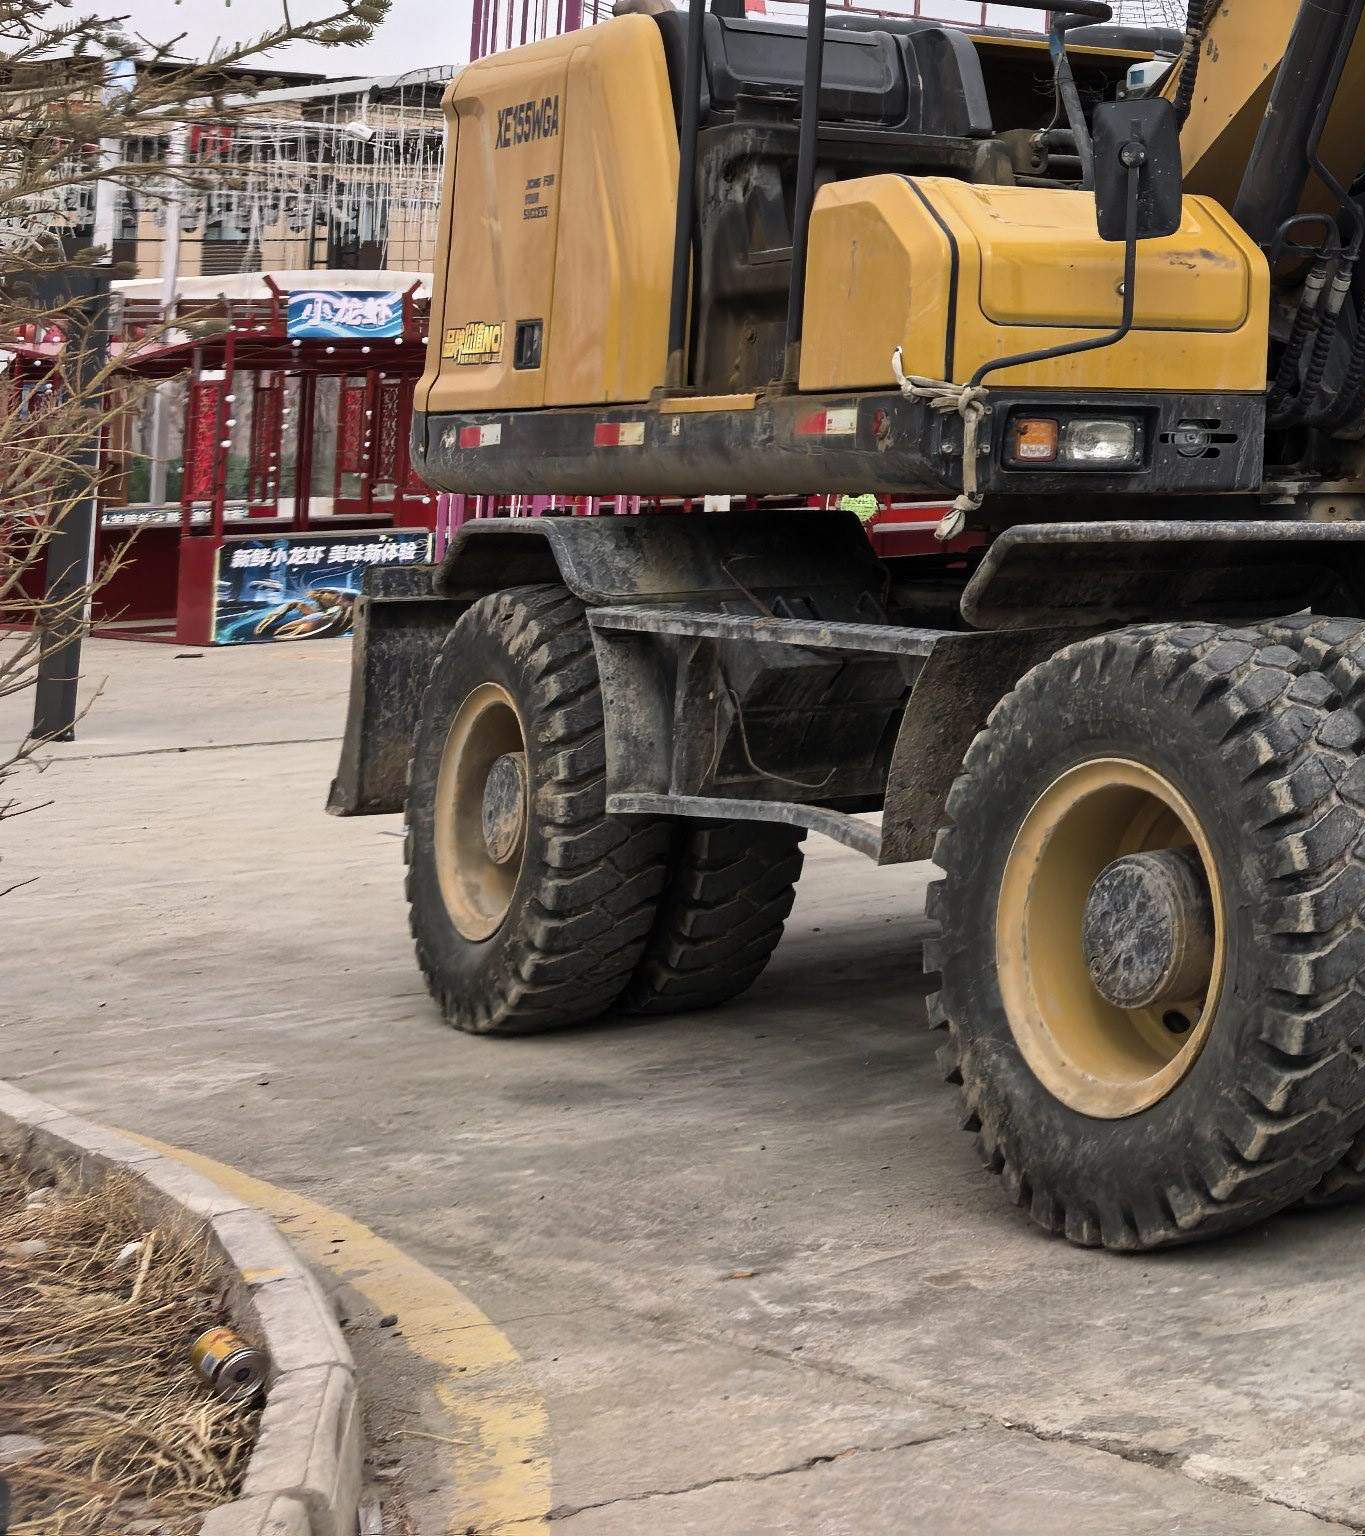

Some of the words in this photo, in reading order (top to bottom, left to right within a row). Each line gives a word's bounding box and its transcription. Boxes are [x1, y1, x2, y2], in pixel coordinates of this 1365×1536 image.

[495, 95, 559, 149] XE155WGA
[301, 297, 394, 326] 小龙虾
[230, 546, 327, 569] 新鲜小龙虾
[327, 541, 417, 566] 美味新体验
